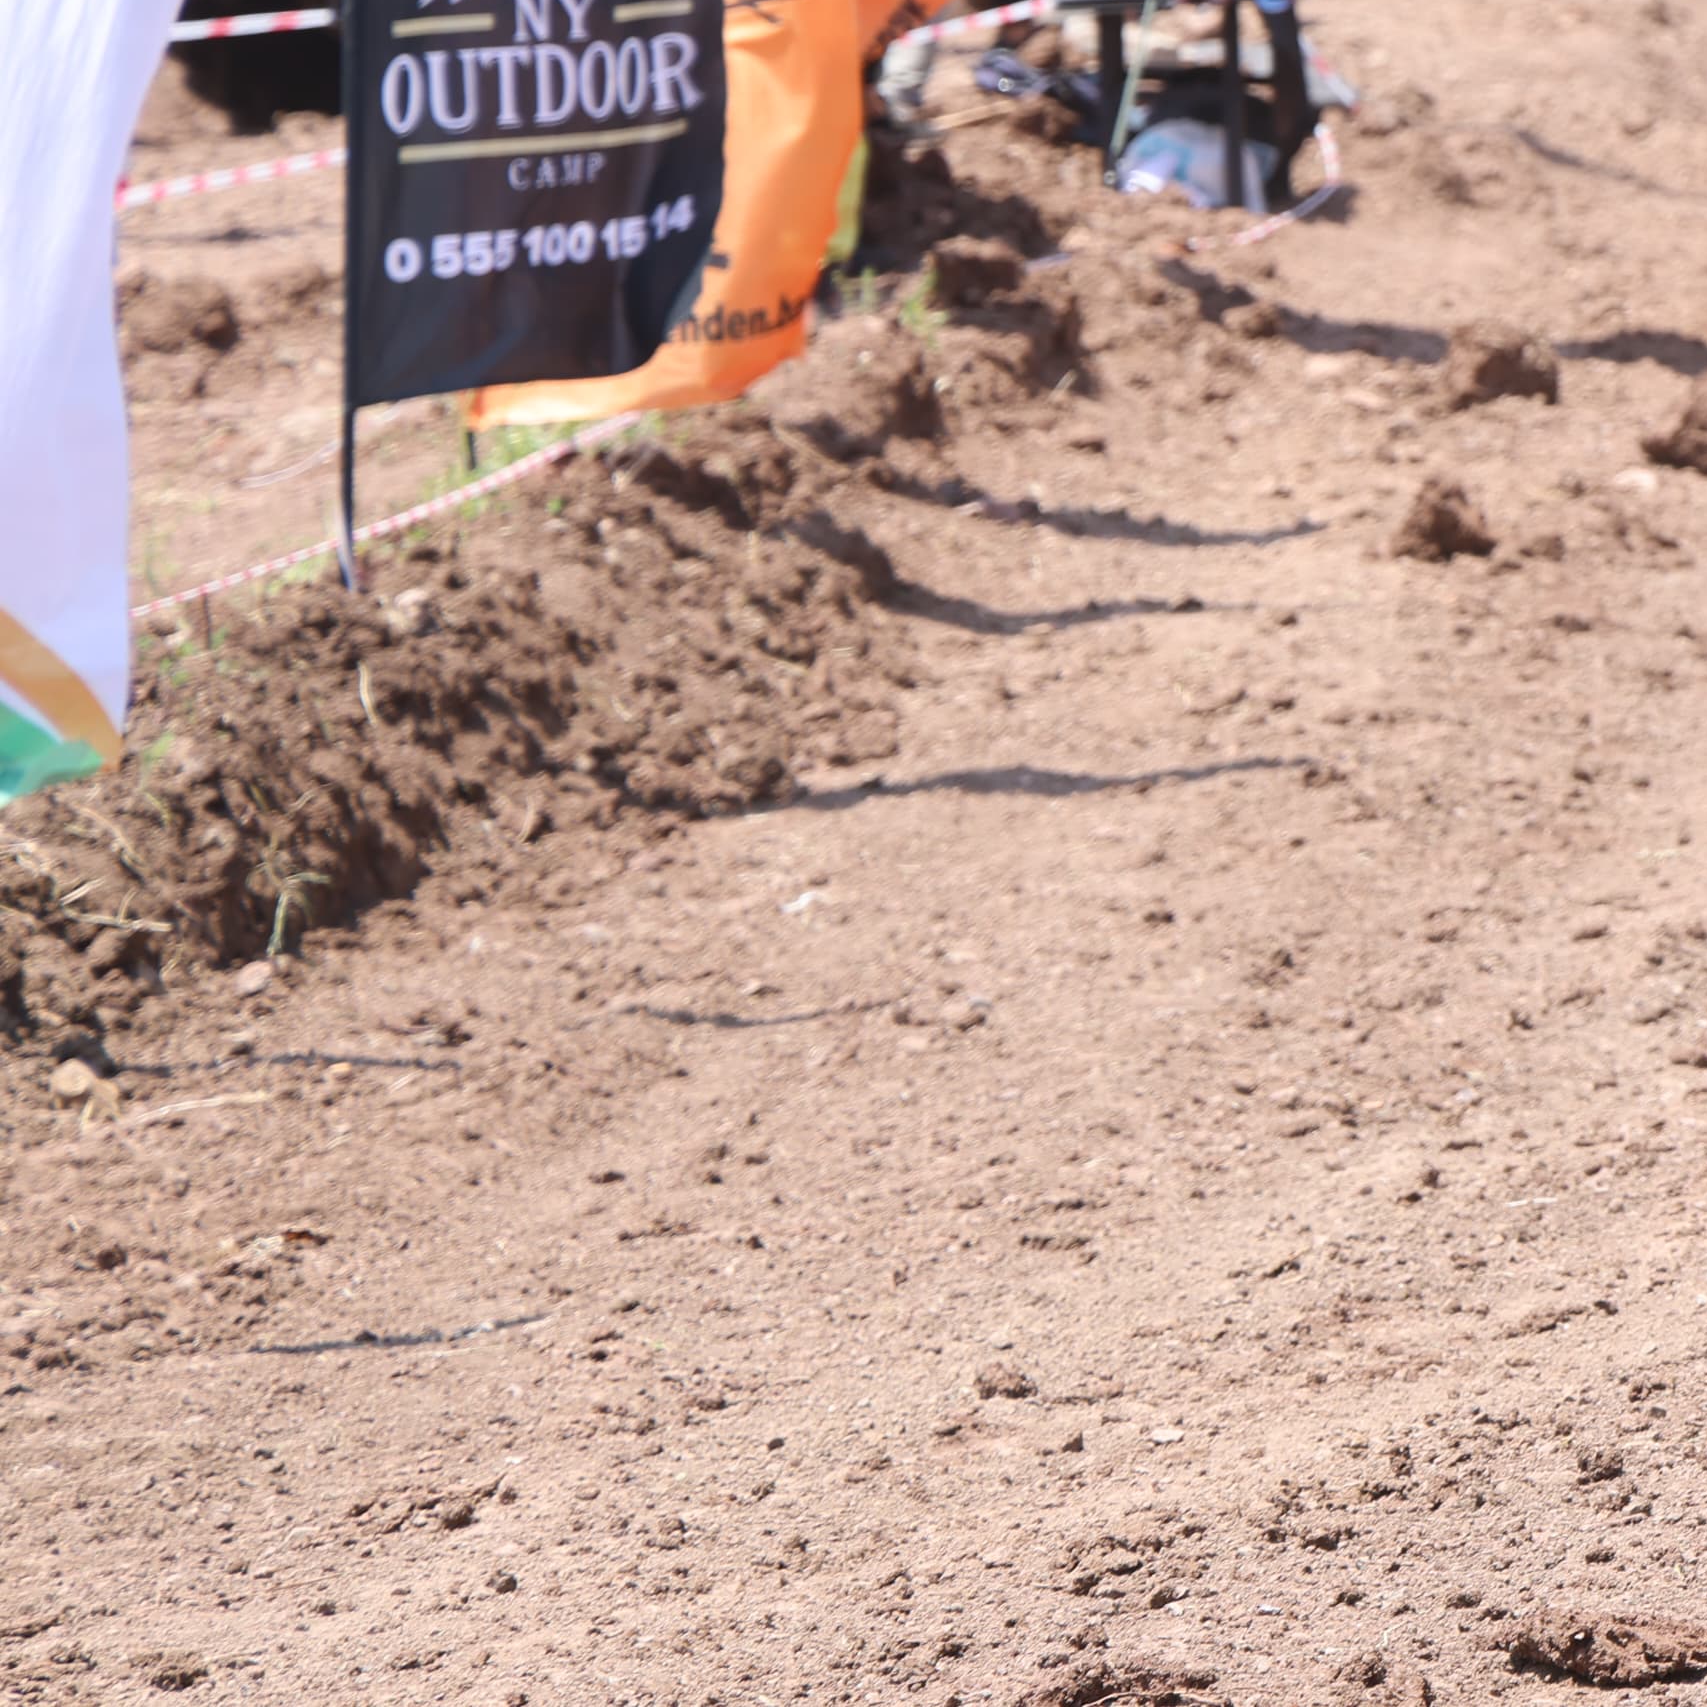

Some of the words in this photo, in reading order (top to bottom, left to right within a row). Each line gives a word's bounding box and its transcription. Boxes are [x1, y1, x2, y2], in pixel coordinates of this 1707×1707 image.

[380, 31, 703, 137] OUTDOOR
[507, 153, 607, 190] CAMP
[522, 220, 598, 267] 100
[601, 213, 649, 261] 15
[652, 193, 696, 240] 14
